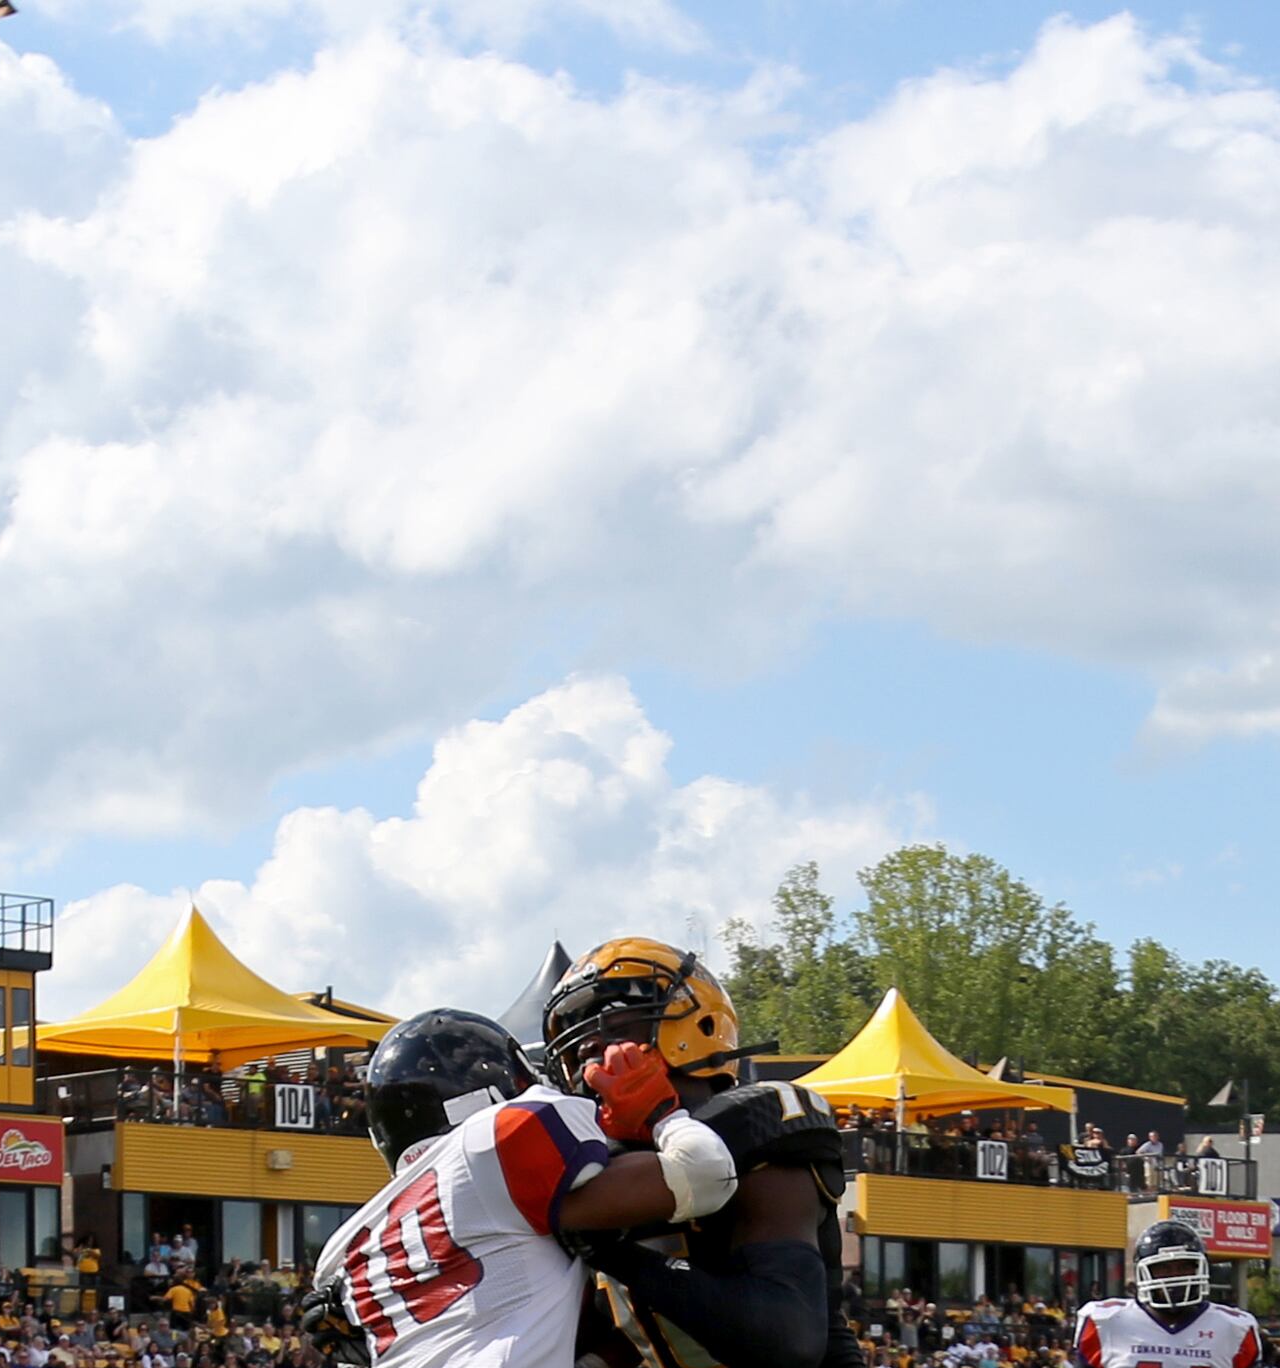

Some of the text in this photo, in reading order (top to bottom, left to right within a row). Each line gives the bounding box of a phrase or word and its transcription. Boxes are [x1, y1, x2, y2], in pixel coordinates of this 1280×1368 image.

[277, 1086, 312, 1126] 104
[980, 1142, 1005, 1177] 102
[1204, 1160, 1224, 1191] 101
[1217, 1210, 1248, 1224] FLOOR
[343, 1167, 485, 1358] 10
[1131, 1344, 1213, 1359] EDWARD WATERS
